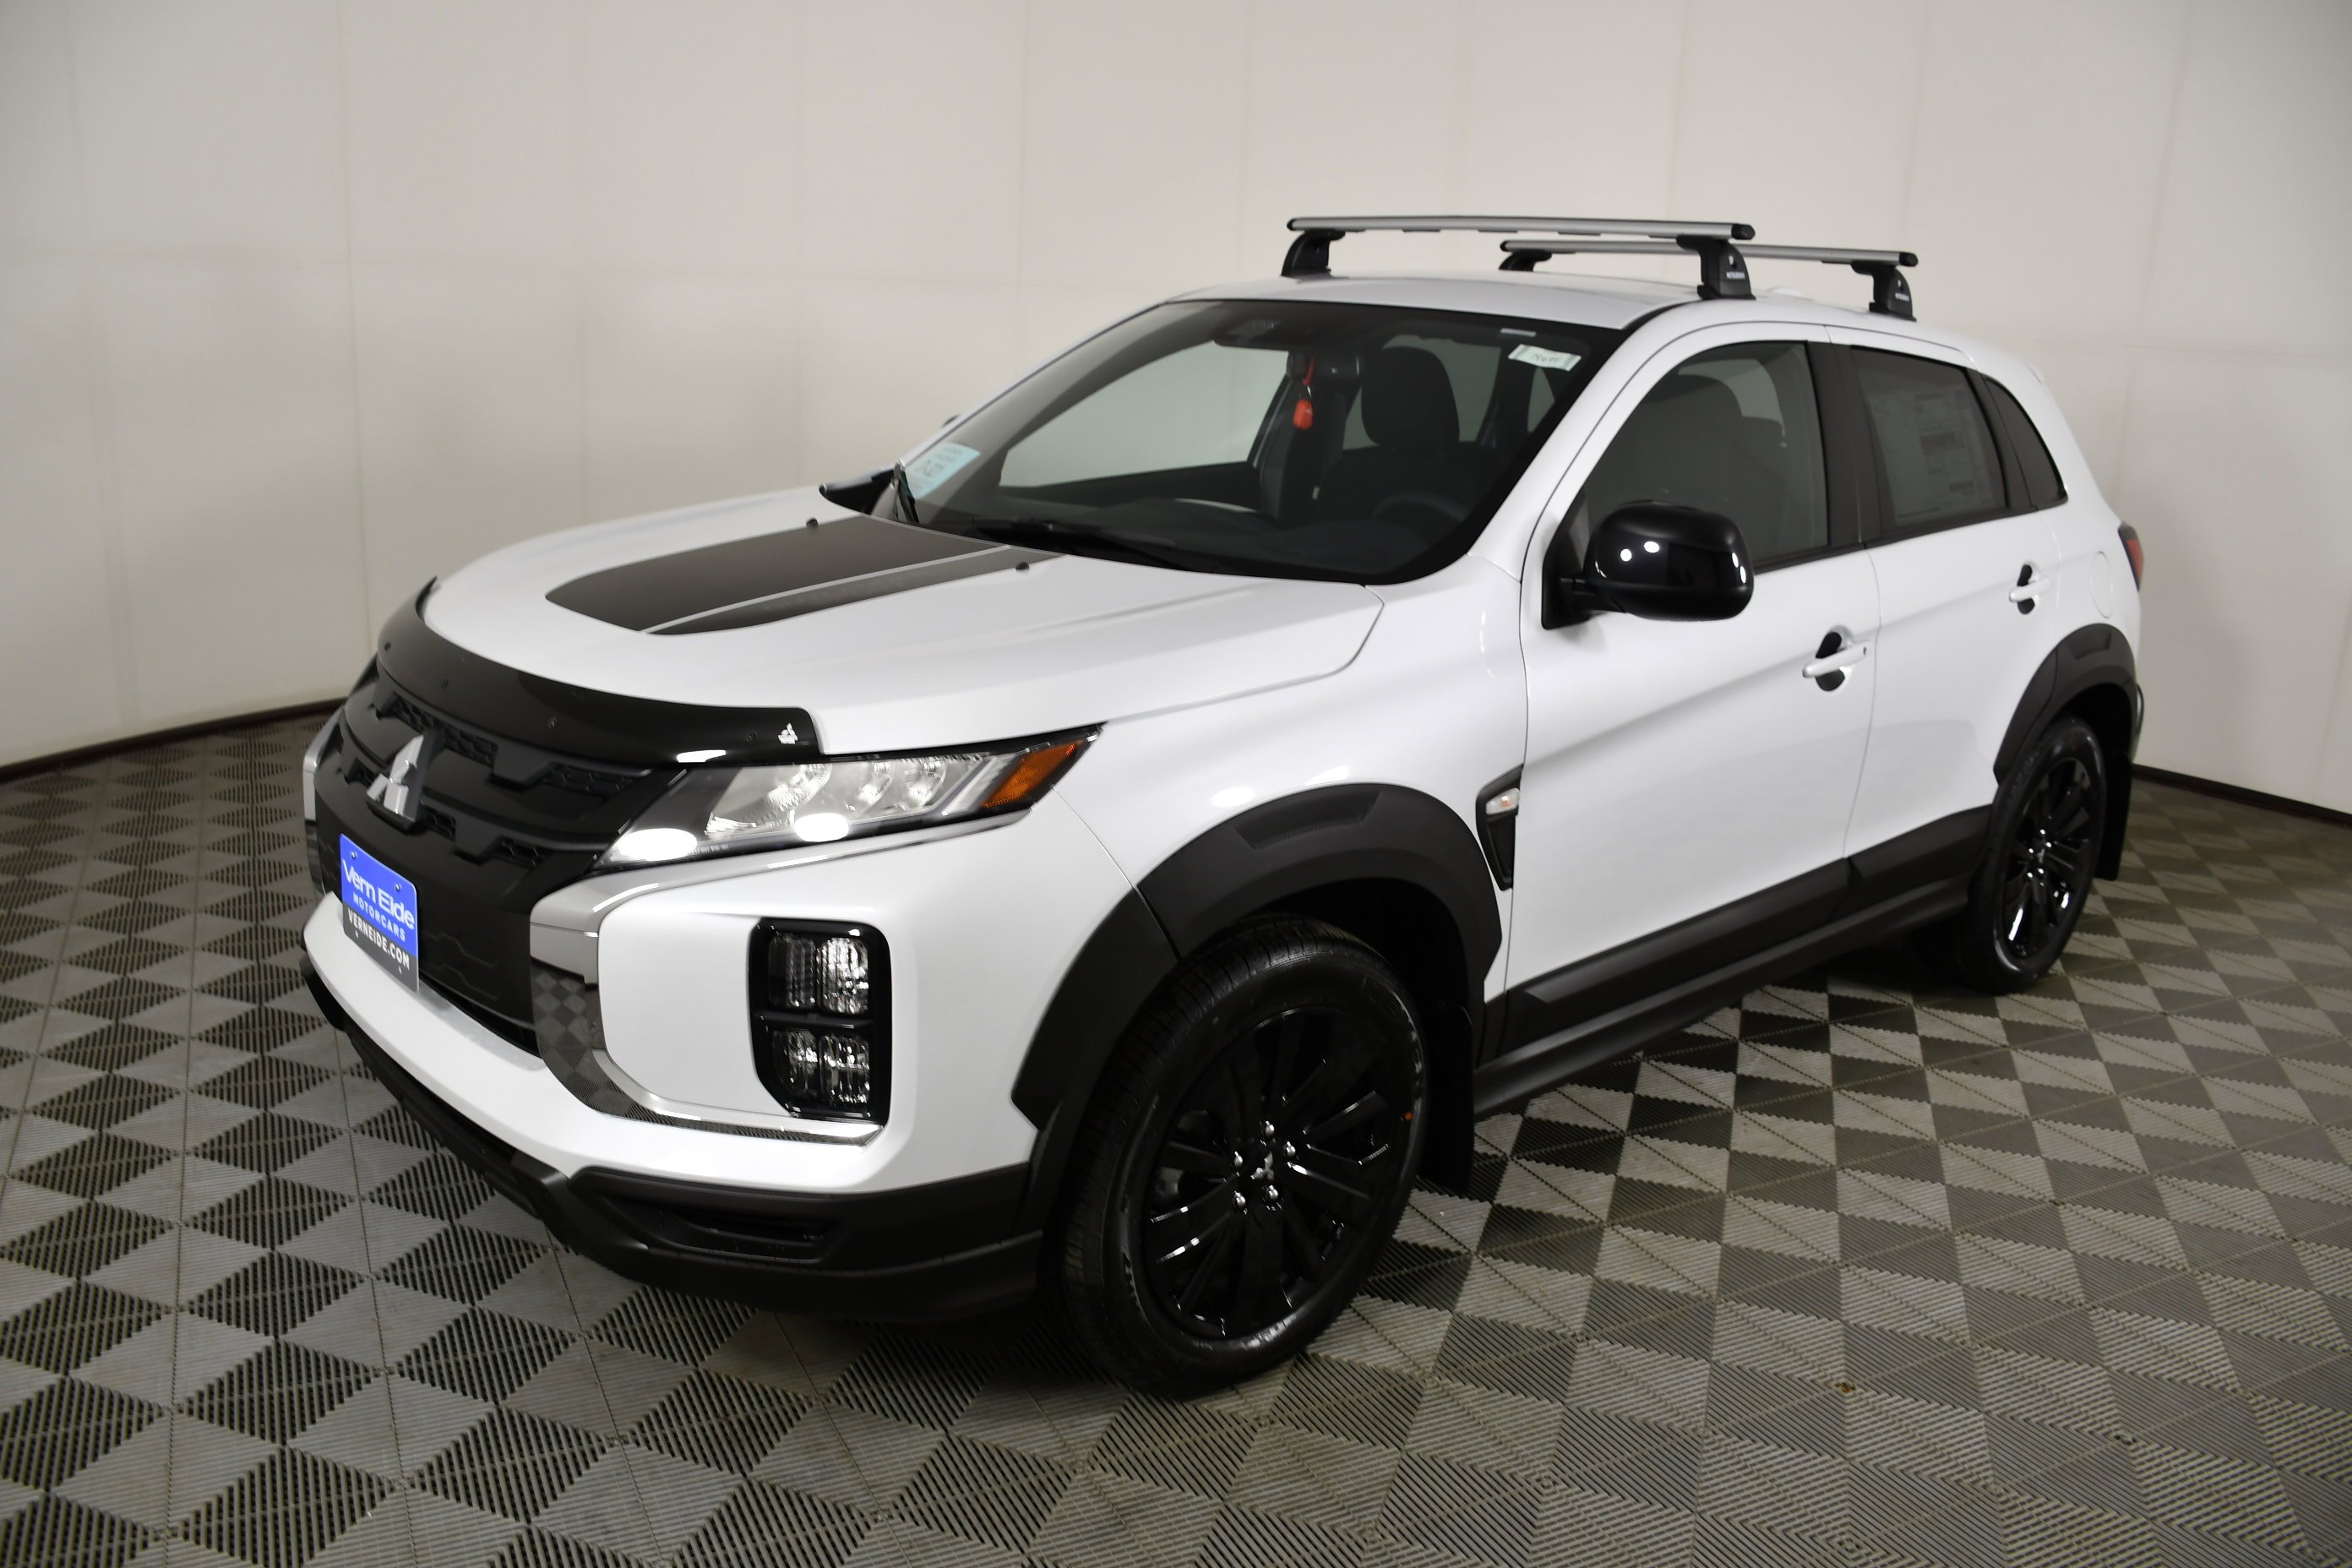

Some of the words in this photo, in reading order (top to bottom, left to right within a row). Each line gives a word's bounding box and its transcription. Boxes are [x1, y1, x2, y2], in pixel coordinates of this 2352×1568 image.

[342, 859, 376, 904] Vern
[378, 887, 416, 931] Eide
[352, 892, 406, 942] MOTORCARS
[347, 907, 411, 970] VERNEIDE.COM
